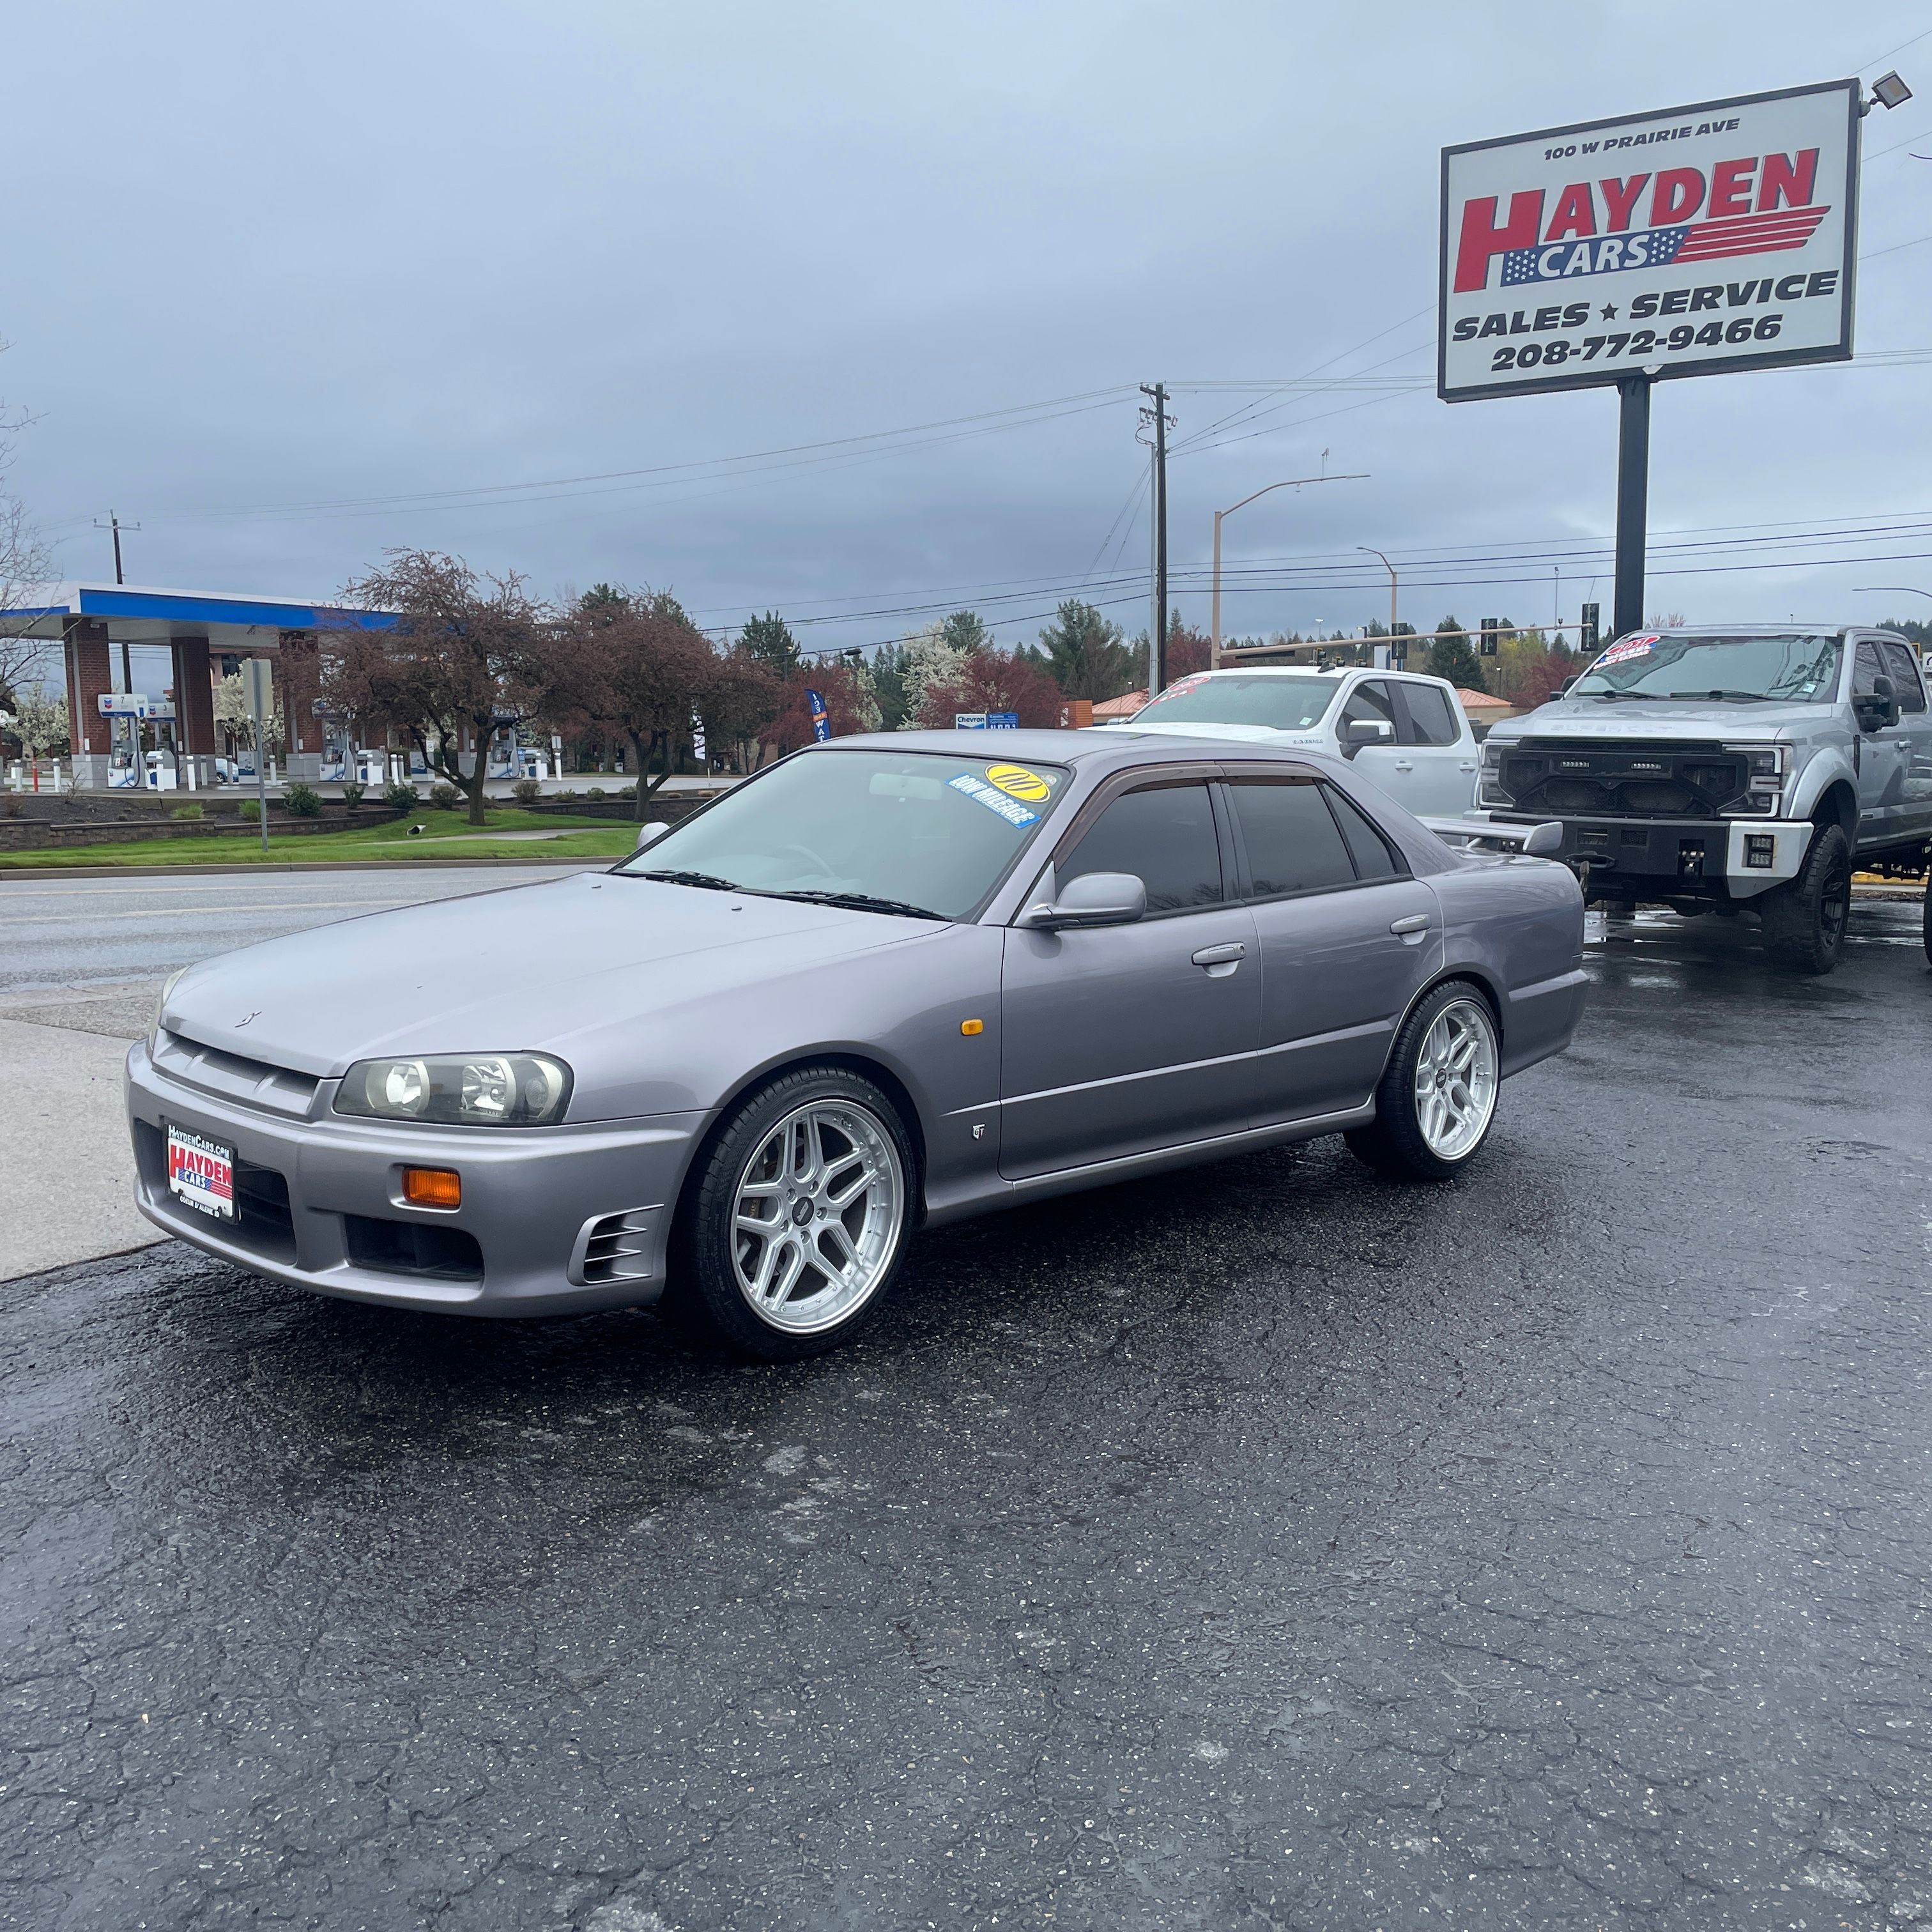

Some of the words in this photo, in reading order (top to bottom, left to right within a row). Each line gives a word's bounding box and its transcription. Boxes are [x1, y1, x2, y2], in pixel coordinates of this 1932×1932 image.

[1544, 143, 1577, 161] 100
[1581, 140, 1600, 155] W
[1603, 125, 1693, 151] PRAIRIE
[1696, 118, 1741, 137] AVE
[1453, 148, 1820, 294] HAYDEN
[1537, 234, 1650, 279] CARS
[1452, 302, 1591, 342] SALES
[1629, 270, 1840, 320] SERVICE
[1491, 314, 1784, 372] 208-772-9466
[948, 774, 988, 794] LOW
[971, 787, 1036, 825] MILEAGE
[170, 1144, 233, 1186] HAYDEN
[184, 1171, 206, 1189] CARS
